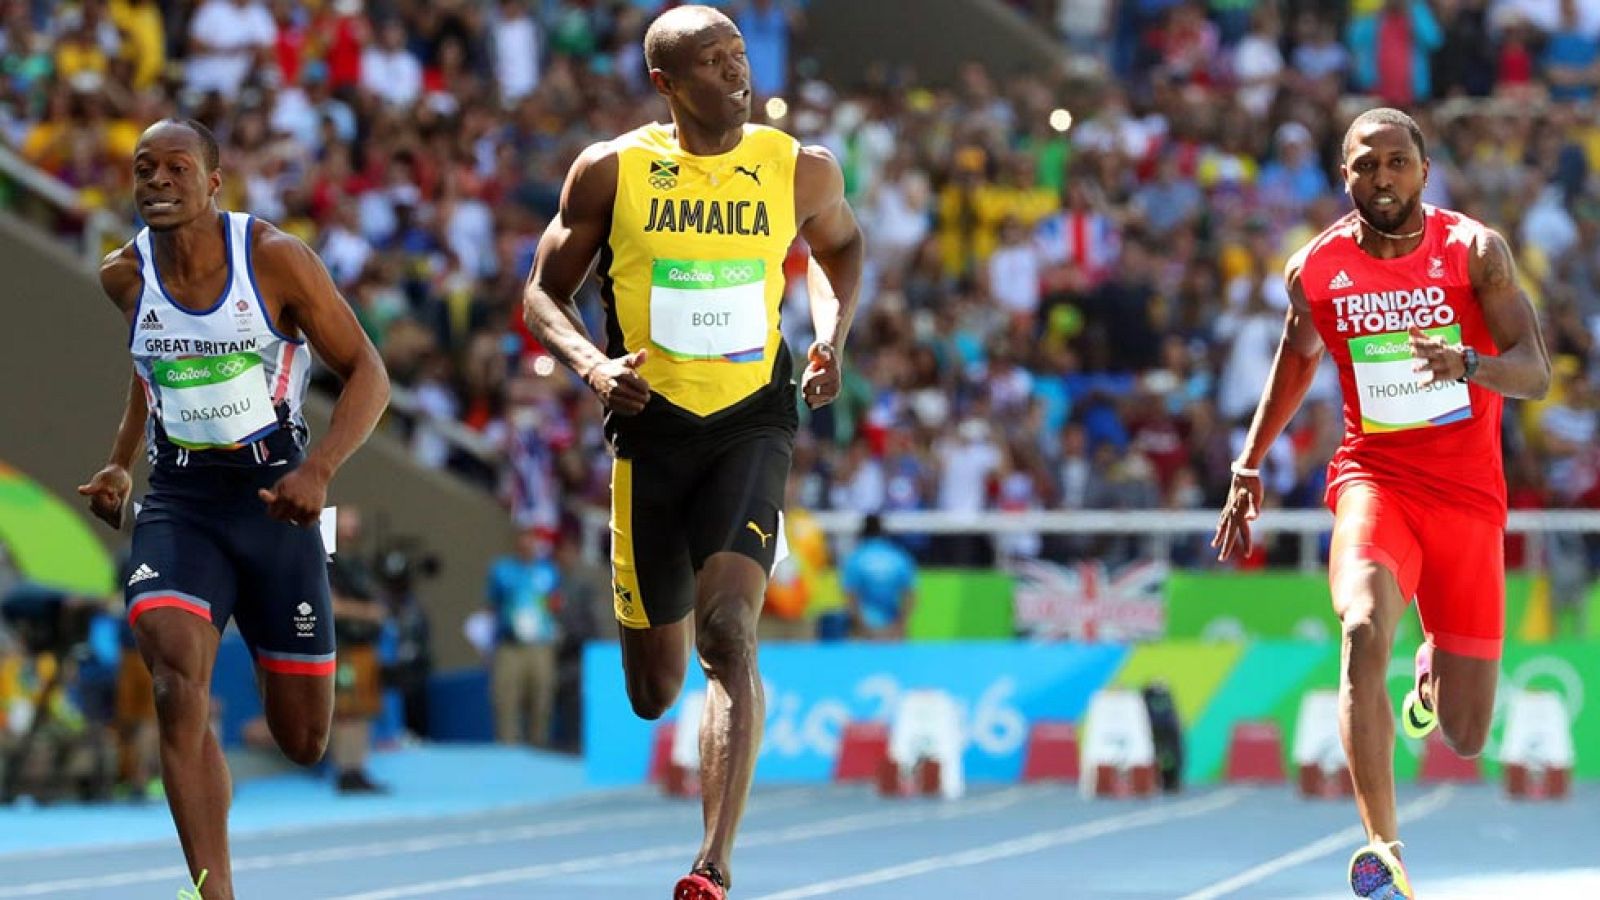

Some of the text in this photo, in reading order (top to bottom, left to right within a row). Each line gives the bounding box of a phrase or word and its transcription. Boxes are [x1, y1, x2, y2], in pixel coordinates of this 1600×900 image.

[644, 198, 770, 236] JAMAICA
[669, 267, 715, 282] Rio2016
[1332, 286, 1446, 316] TRINIDAD
[691, 312, 731, 326] BOLT
[145, 338, 256, 354] GREAT BRITAIN
[166, 366, 211, 382] Rio2016
[180, 398, 251, 422] DASAOLU
